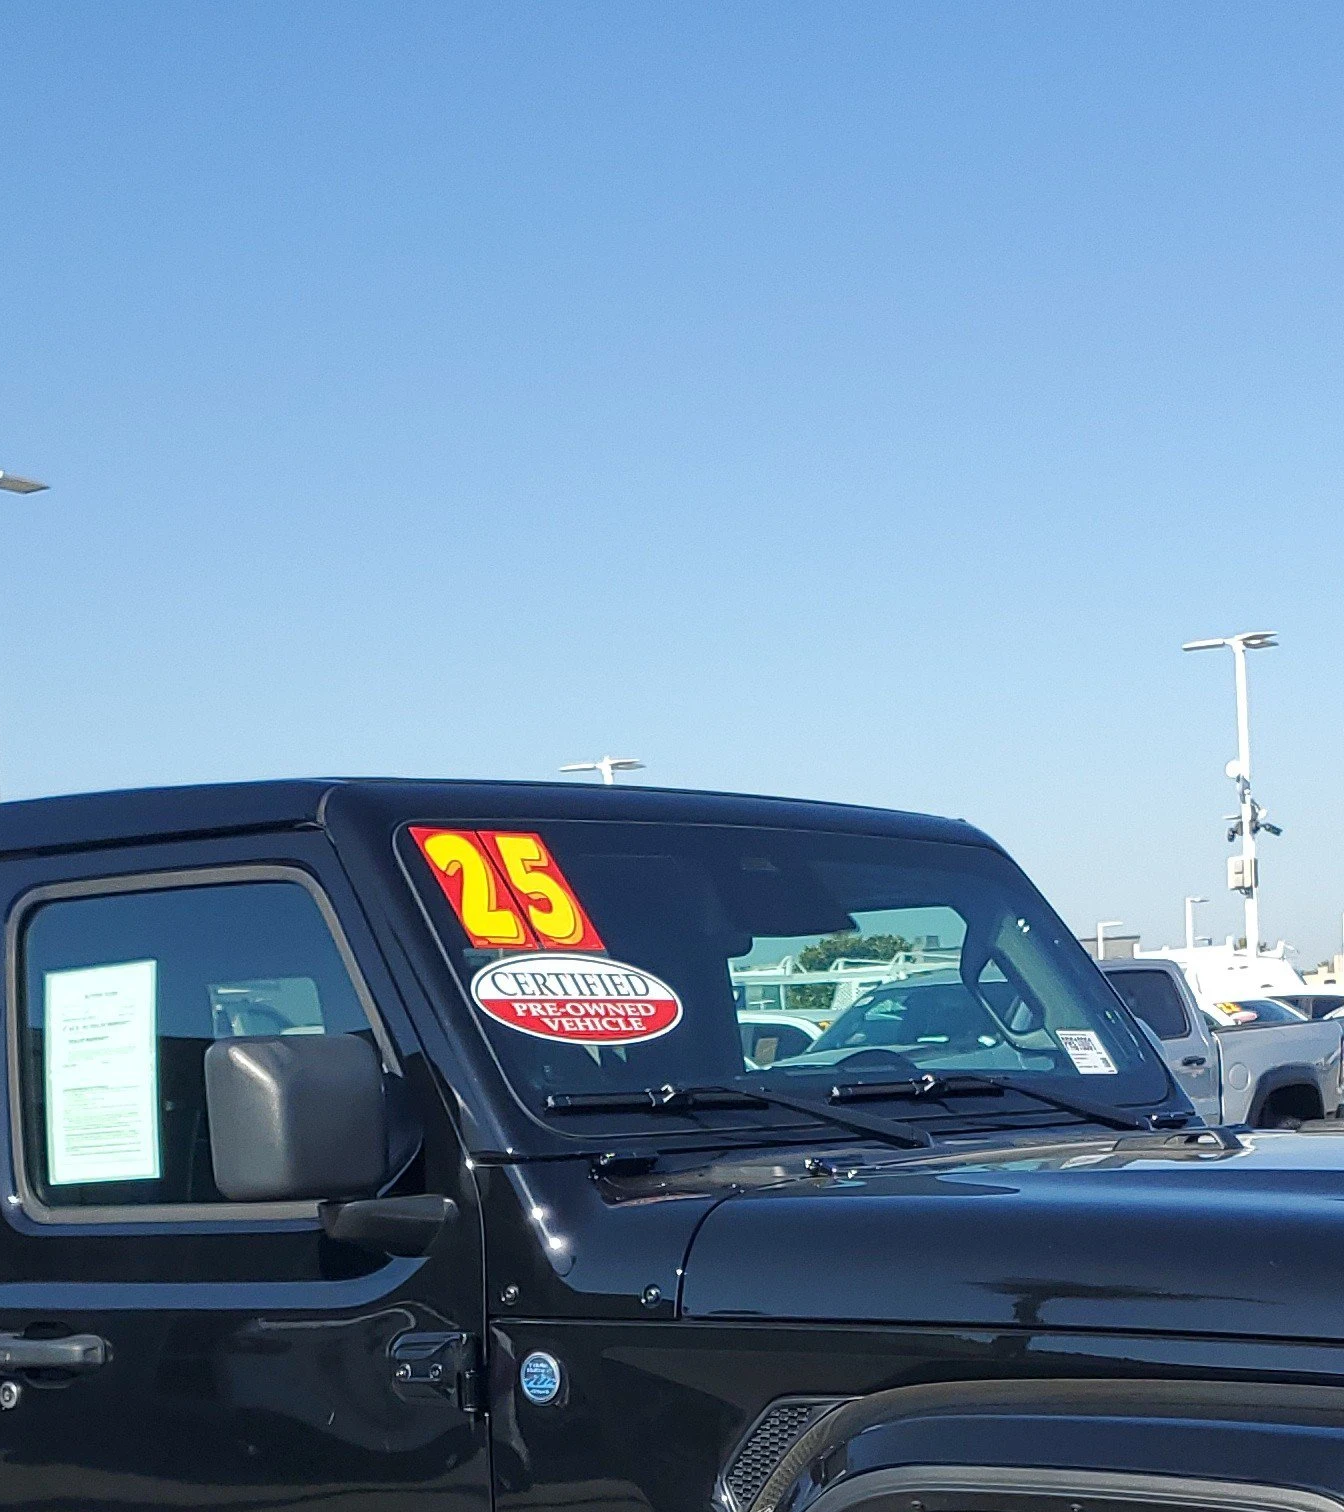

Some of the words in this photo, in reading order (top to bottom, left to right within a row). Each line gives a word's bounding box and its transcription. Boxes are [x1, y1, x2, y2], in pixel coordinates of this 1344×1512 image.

[423, 832, 584, 945] 25
[490, 971, 650, 998] CERTIFIED
[515, 1002, 656, 1018] PRE-OWNED
[540, 1016, 648, 1032] VEHICLE
